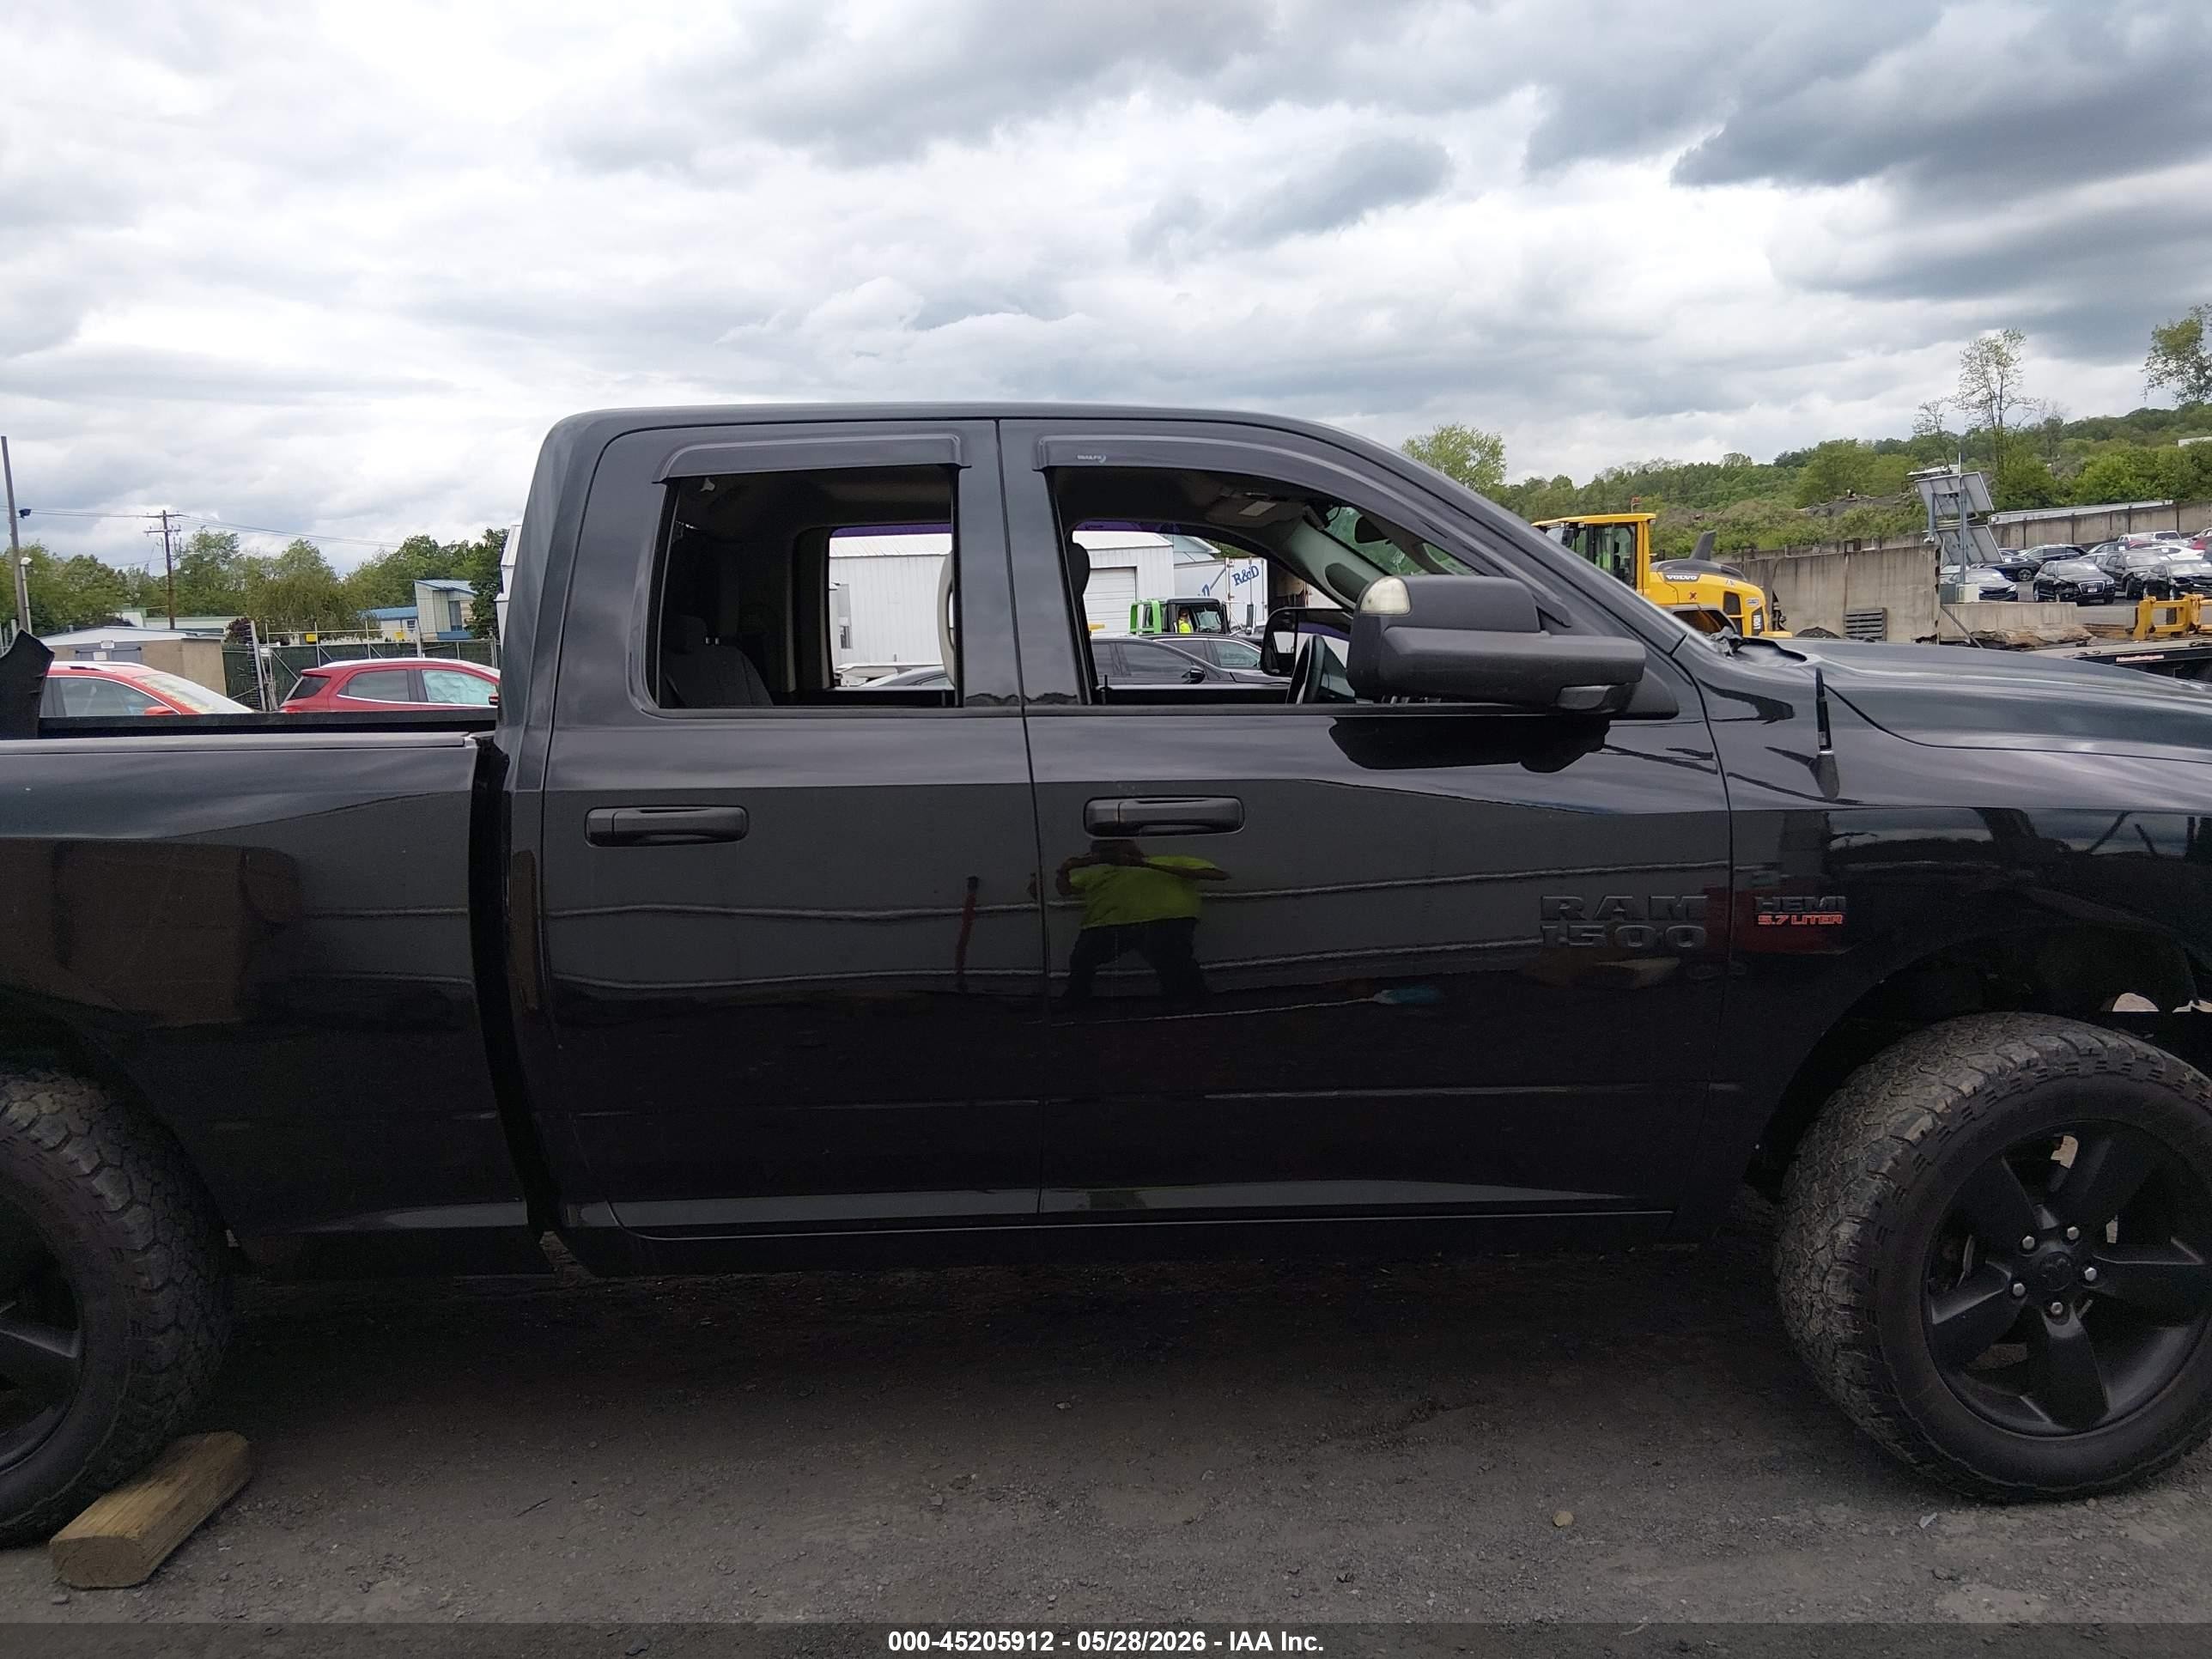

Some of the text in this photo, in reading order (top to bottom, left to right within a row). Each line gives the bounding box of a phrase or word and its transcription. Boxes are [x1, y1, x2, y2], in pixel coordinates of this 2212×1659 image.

[1540, 896, 1708, 921] RAM
[1755, 896, 1847, 913] HEMI
[1758, 915, 1844, 925] 5.7 LITER
[1540, 925, 1707, 949] 1500
